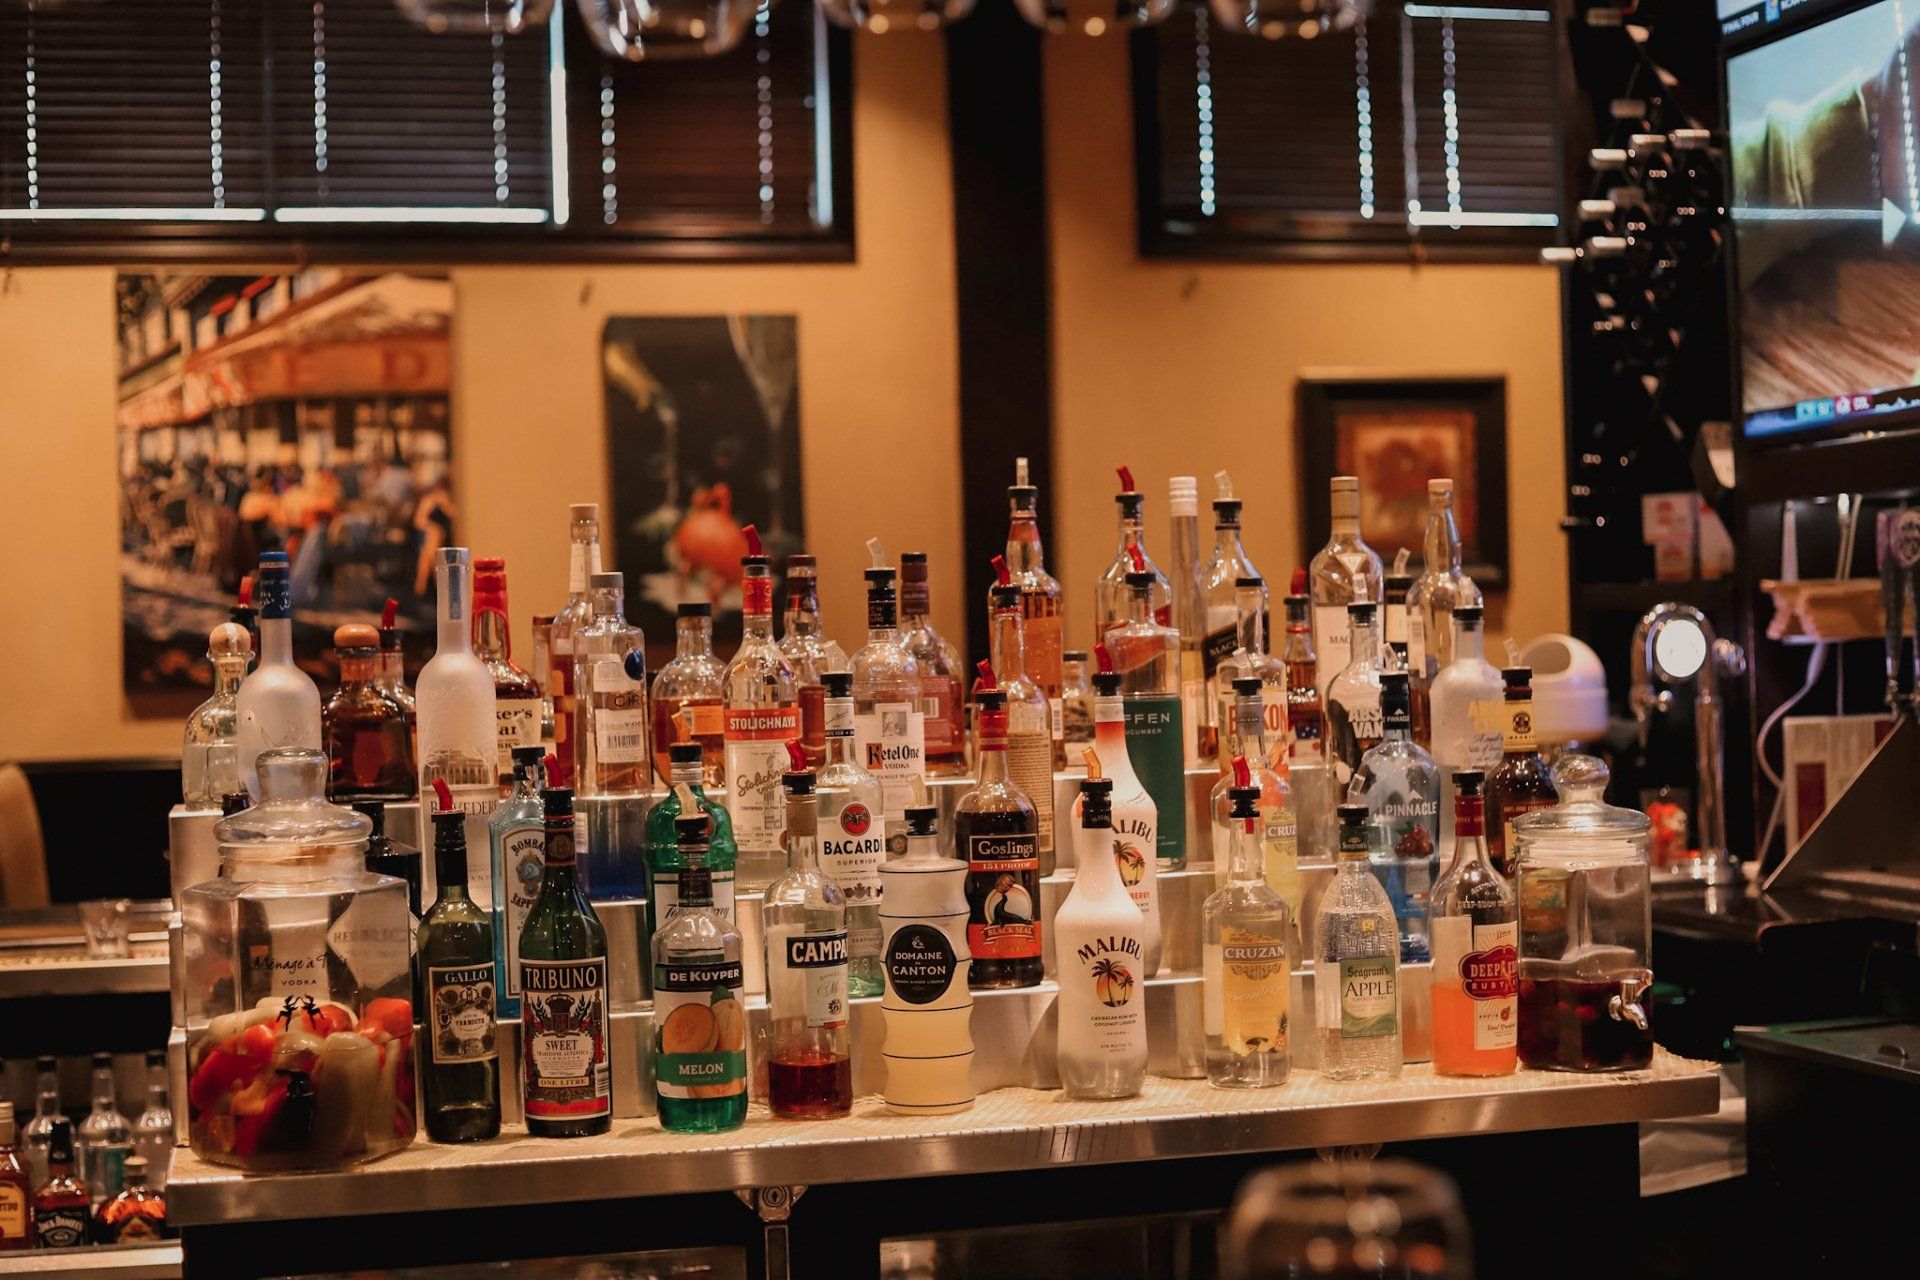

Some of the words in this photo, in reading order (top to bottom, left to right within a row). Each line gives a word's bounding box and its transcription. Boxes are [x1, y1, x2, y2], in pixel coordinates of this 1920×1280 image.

[729, 715, 796, 730] STOLICHNAYA
[1124, 712, 1170, 724] FFEN
[1126, 728, 1162, 736] UCUMBER
[868, 744, 900, 765] Ketel
[902, 744, 920, 760] One
[1385, 801, 1437, 816] PINNACLE
[1112, 819, 1154, 844] LIBU
[1268, 824, 1297, 837] CRUZ
[511, 838, 545, 857] BOMBA
[978, 840, 1034, 857] Goslings
[837, 858, 877, 866] SUPERIOR
[987, 927, 1014, 936] BLACK
[1015, 926, 1033, 935] SEAL
[792, 938, 848, 963] CAMPA
[895, 952, 943, 960] DOMAINE
[1077, 936, 1143, 965] MALIBU
[1225, 945, 1285, 959] CRUZAN
[445, 969, 487, 983] GALLO
[525, 966, 597, 989] TRIBUNO
[669, 972, 687, 982] DE
[690, 968, 740, 982] KUYPER
[892, 965, 946, 976] CANTON
[1347, 965, 1390, 979] Seagram's
[1470, 963, 1500, 978] DEEP
[1344, 980, 1394, 997] APPLE
[1472, 981, 1505, 991] RUBY
[545, 1039, 577, 1051] SWEET
[679, 1063, 724, 1075] MELON
[560, 1077, 586, 1085] LITRE
